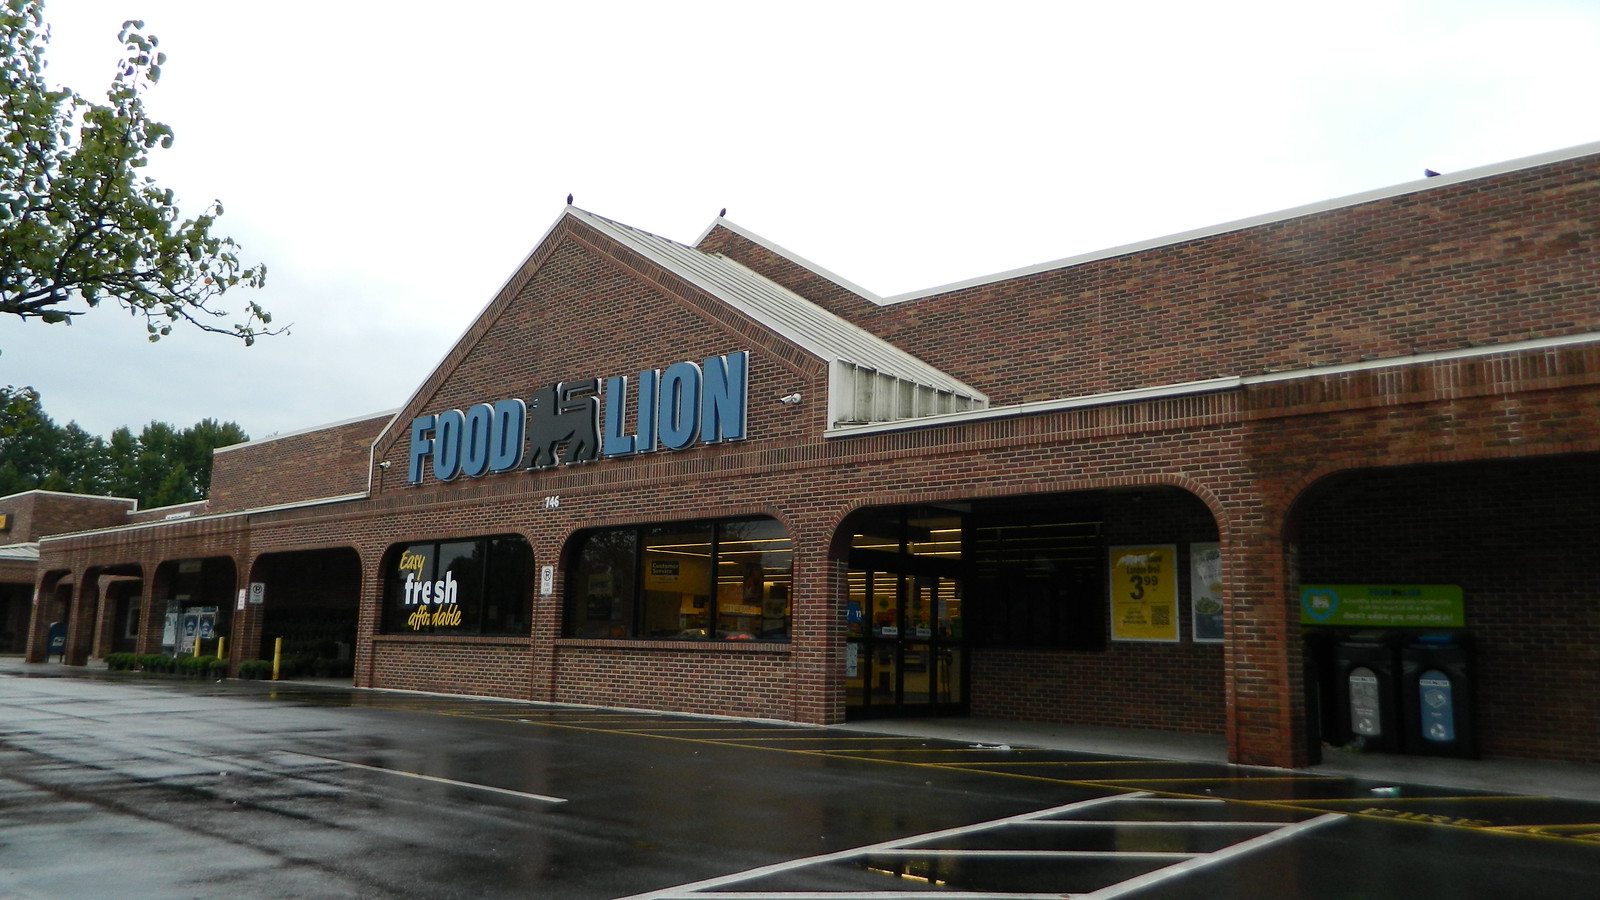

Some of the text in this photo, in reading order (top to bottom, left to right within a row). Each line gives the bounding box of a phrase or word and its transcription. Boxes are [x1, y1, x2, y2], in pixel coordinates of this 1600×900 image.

[408, 350, 750, 484] FOOD LION
[545, 496, 560, 508] 746
[400, 550, 426, 581] Easy
[405, 571, 458, 605] fresh
